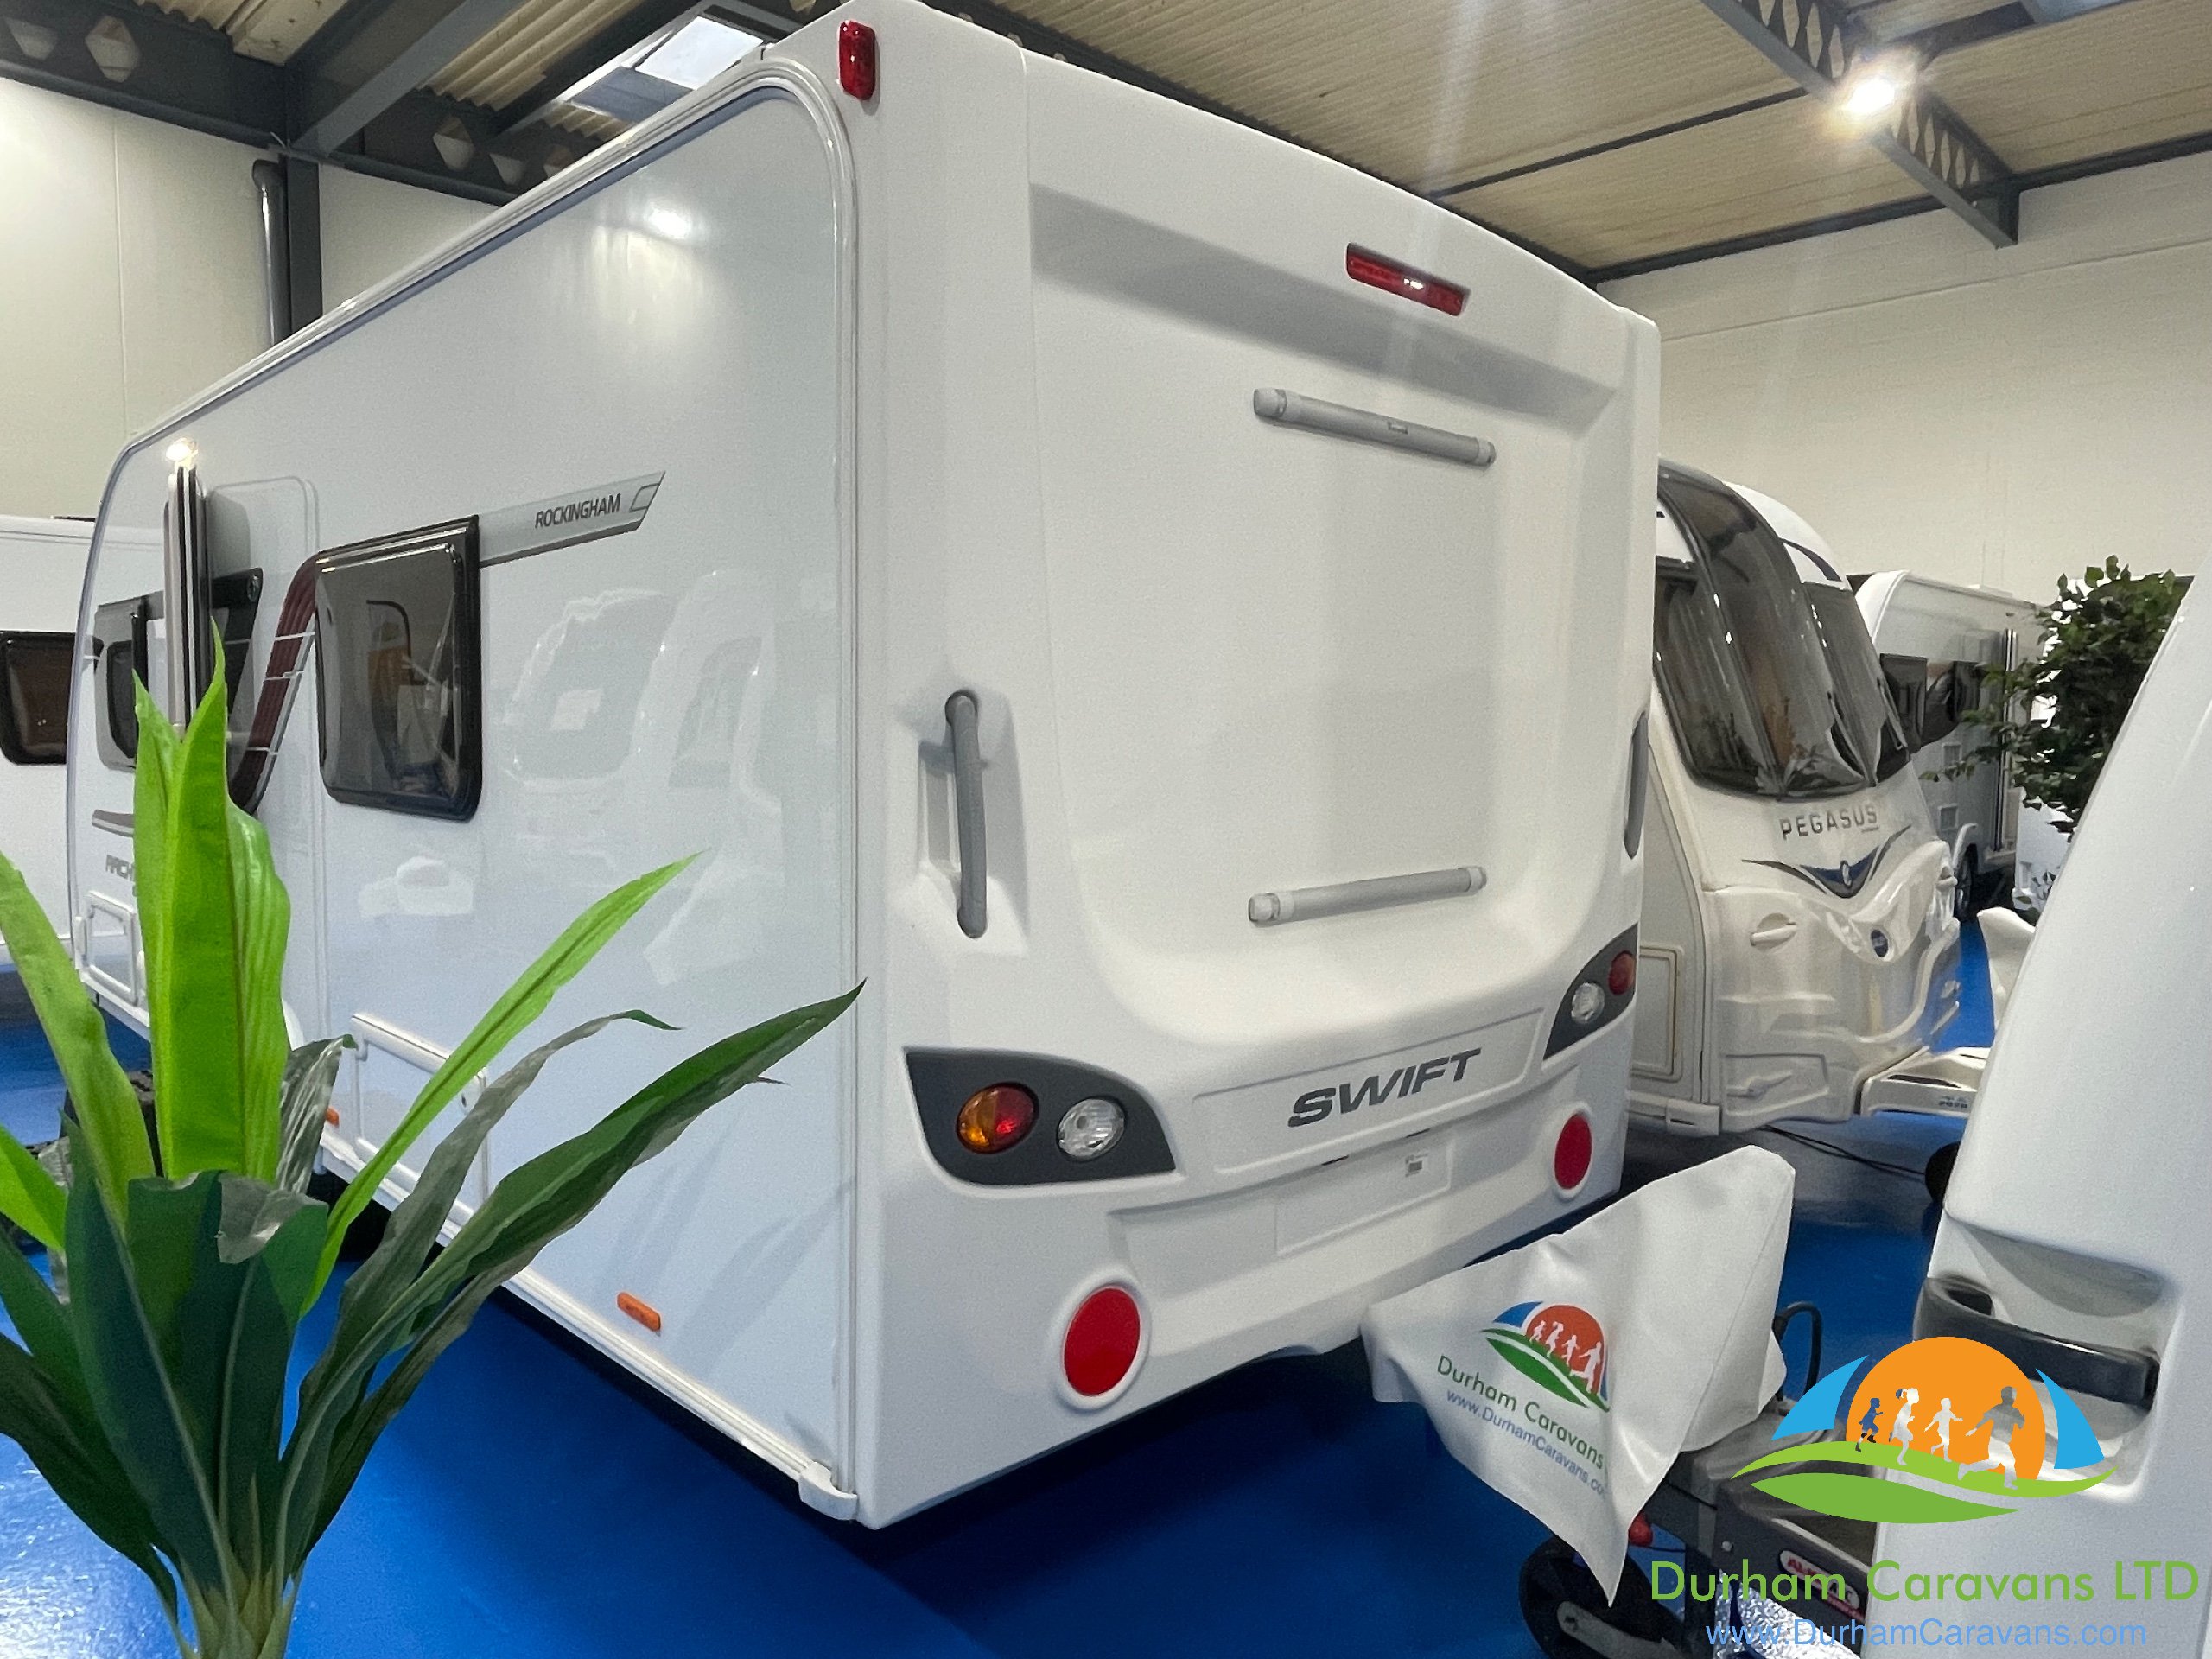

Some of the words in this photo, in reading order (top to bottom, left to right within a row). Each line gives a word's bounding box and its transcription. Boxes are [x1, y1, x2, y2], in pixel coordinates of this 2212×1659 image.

[535, 493, 621, 530] ROCKINGHAM
[1779, 804, 1878, 842] PEGASUS
[1287, 1047, 1482, 1128] SWIFT
[1437, 1355, 1516, 1412] Durham
[1524, 1401, 1605, 1469] Caravans
[1446, 1389, 1606, 1497] www.DurhamCaravans.co
